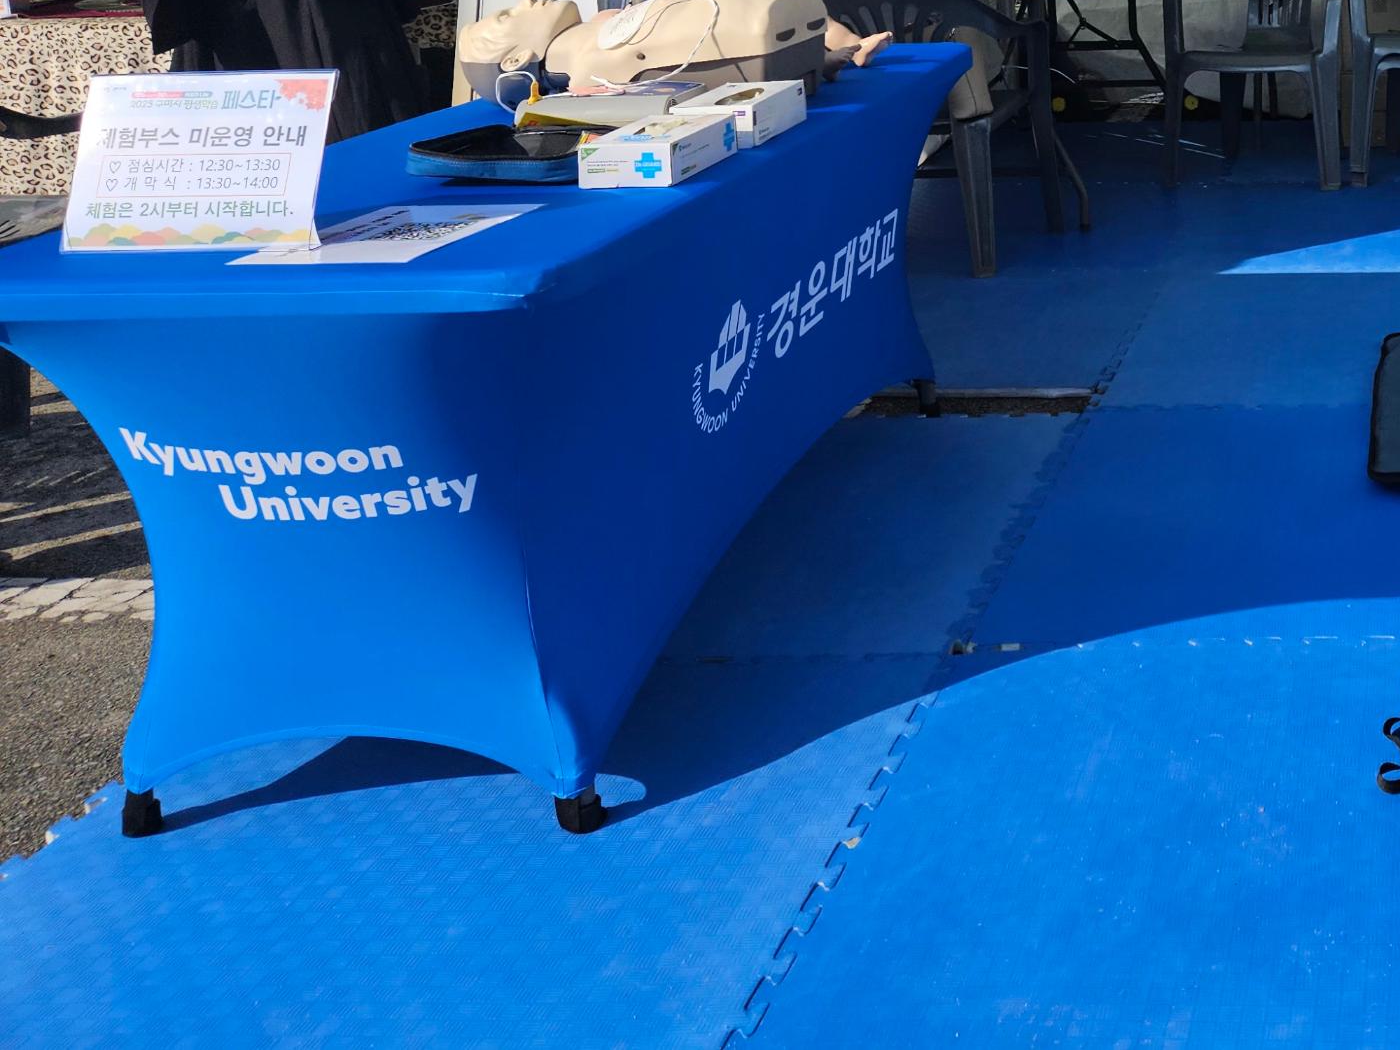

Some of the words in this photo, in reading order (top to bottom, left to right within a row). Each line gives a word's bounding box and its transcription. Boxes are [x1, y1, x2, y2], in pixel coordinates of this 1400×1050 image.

[221, 89, 282, 110] 페스타
[189, 125, 253, 148] 미운영
[263, 125, 308, 147] 안내
[128, 159, 185, 174] 점심시간
[199, 159, 281, 172] 12:30~13:30
[124, 177, 138, 191] 개
[144, 177, 157, 190] 막
[164, 176, 177, 190] 식
[197, 177, 278, 190] 13:30~14:00
[85, 202, 134, 219] 체험은
[140, 202, 198, 218] 2시부터
[205, 201, 294, 219] 시작합니다.
[767, 208, 898, 358] 경운대학교
[692, 362, 728, 433] KYUNGWOON
[731, 313, 765, 412] UNIVERSITY
[118, 427, 404, 485] Kyungwoon
[218, 474, 478, 522] University
